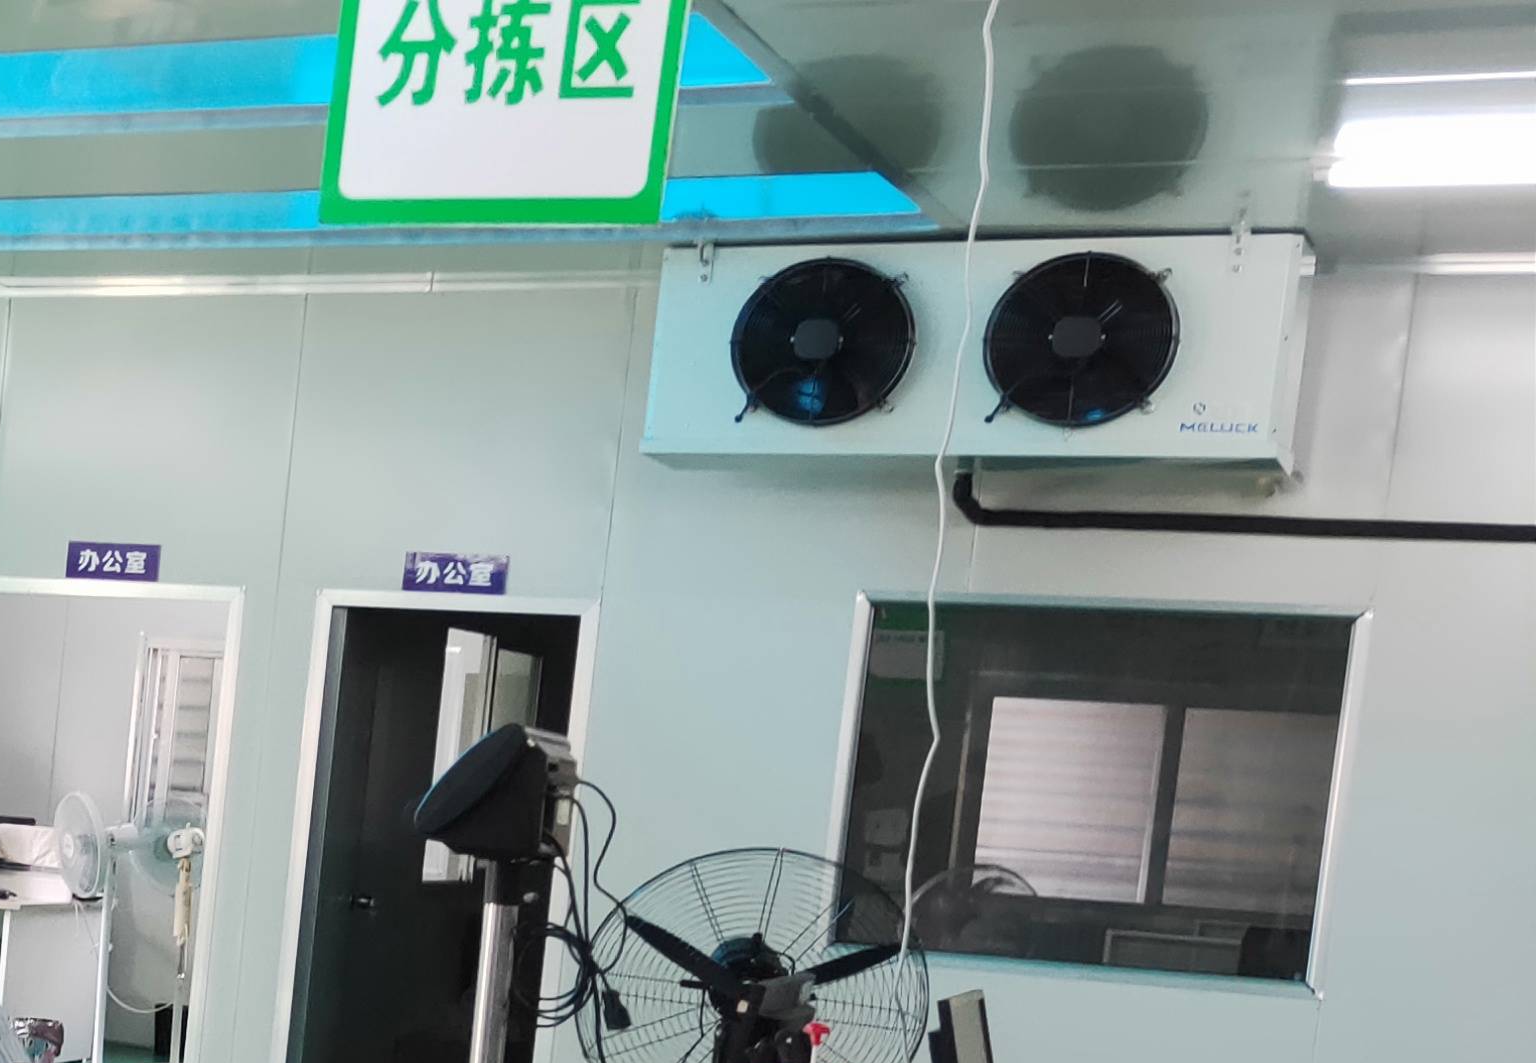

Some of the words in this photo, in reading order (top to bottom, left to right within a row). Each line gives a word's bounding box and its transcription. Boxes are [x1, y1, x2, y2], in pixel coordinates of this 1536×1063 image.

[376, 0, 640, 107] 分拣区
[77, 549, 147, 574] 办公室
[415, 560, 495, 586] 办公室
